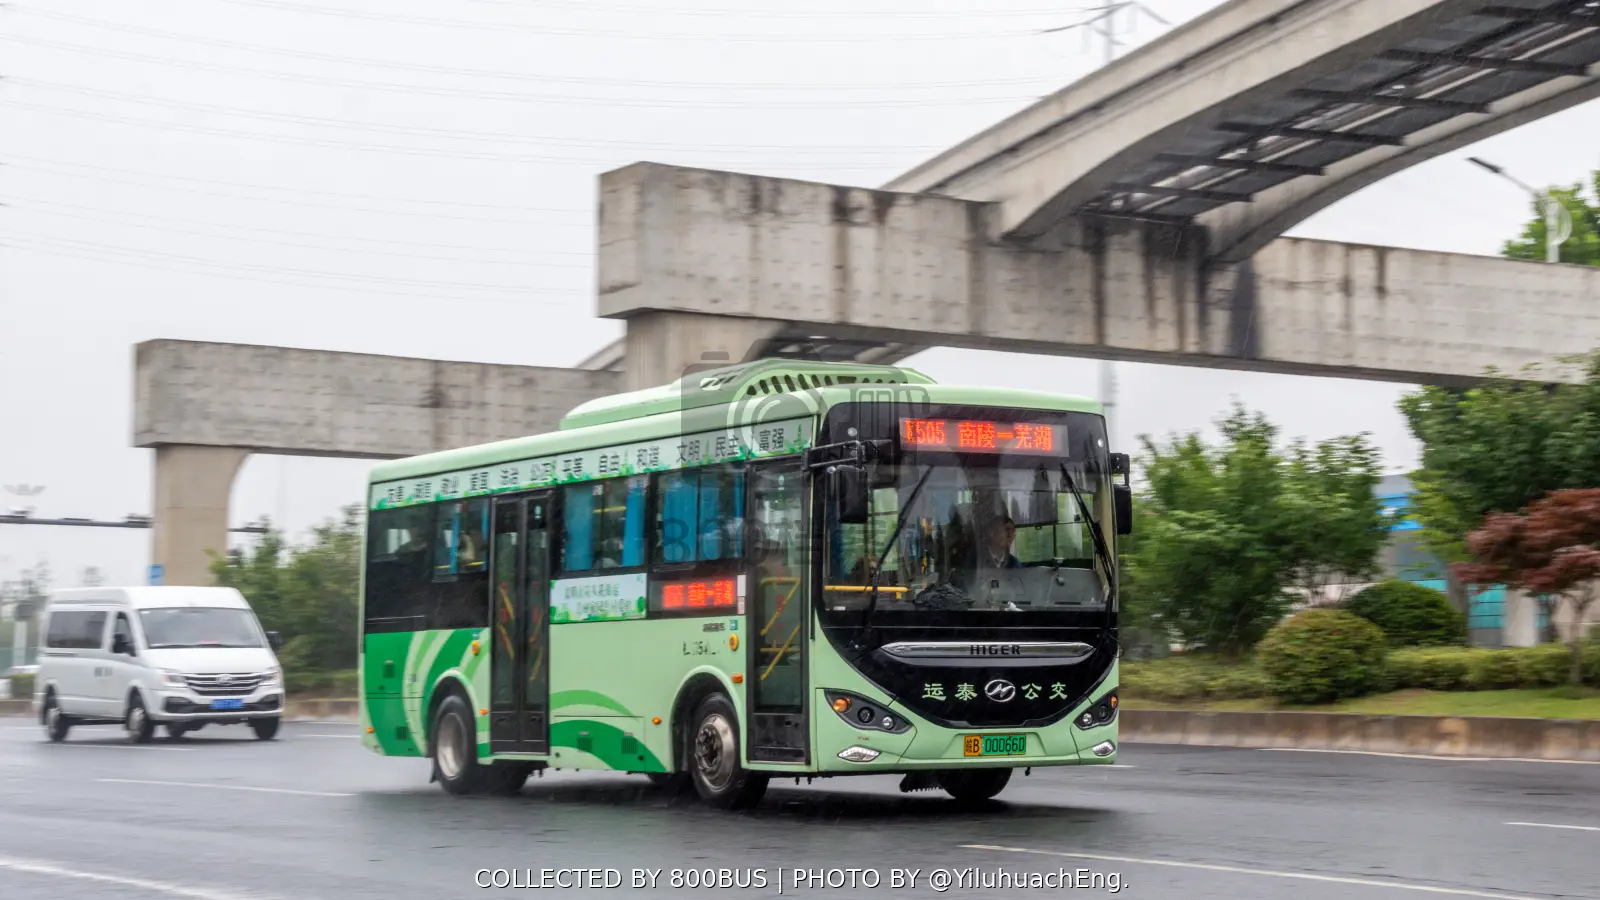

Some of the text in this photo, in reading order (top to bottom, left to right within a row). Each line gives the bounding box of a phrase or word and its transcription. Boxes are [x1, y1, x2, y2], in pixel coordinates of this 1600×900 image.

[599, 452, 620, 473] 自由
[676, 440, 700, 463] 文明
[714, 435, 740, 457] 民主
[759, 428, 784, 451] 富强
[970, 645, 1021, 655] HIGER
[922, 682, 1068, 701] 运泰 公交
